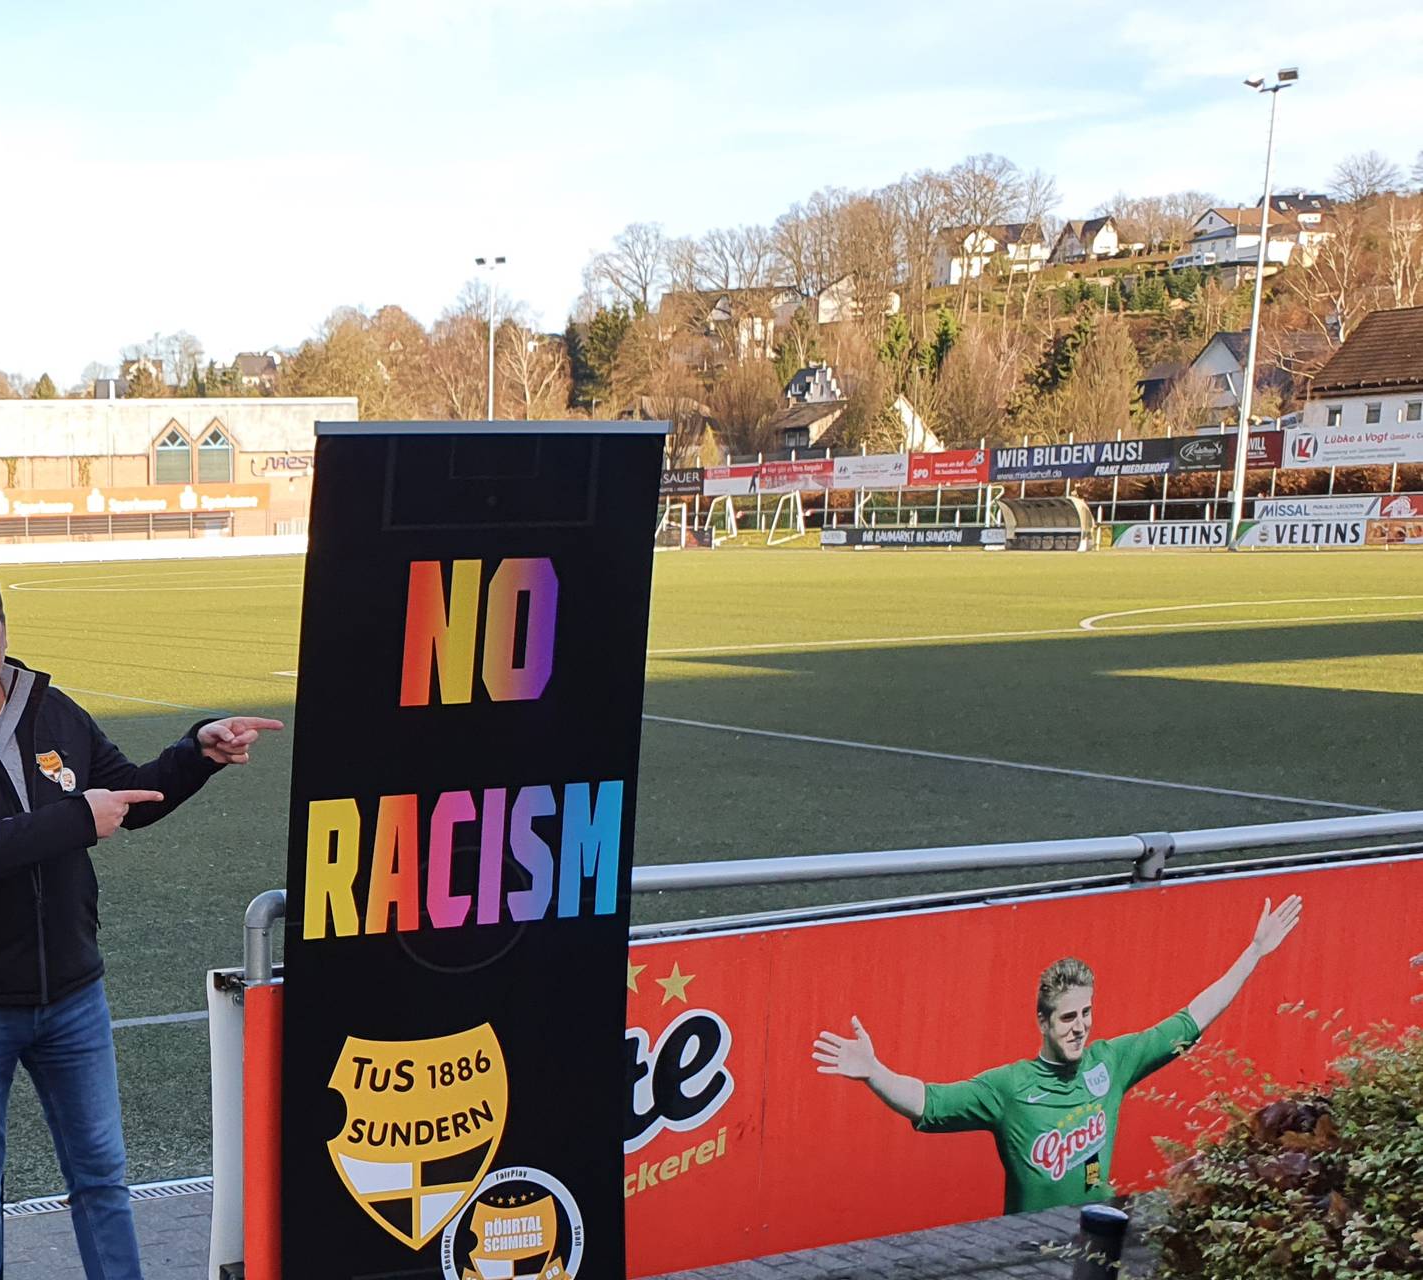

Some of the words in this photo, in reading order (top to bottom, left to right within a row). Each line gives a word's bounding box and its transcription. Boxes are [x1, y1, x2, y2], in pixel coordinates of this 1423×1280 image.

[1365, 432, 1388, 445] Vogt
[997, 449, 1028, 468] WIR
[1033, 445, 1096, 466] BILDEN
[1100, 441, 1143, 462] AUS!
[663, 471, 700, 485] SAUER
[913, 468, 929, 479] SPD
[1094, 465, 1120, 476] FRANZ
[1120, 462, 1170, 475] MIEDERHOFF
[1261, 504, 1310, 517] MISSAL
[876, 530, 915, 542] BAUMARKT
[1147, 524, 1223, 545] VELTINS
[1275, 523, 1361, 545] VELTINS
[399, 557, 559, 707] NO
[303, 779, 624, 940] RACISM
[351, 1056, 415, 1093] TuS
[426, 1049, 492, 1090] 1886
[347, 1099, 495, 1148] SUNDERN
[1032, 1110, 1106, 1180] Grote
[495, 1169, 528, 1180] FairPlay
[483, 1216, 543, 1237] RÖHRTAL
[444, 1235, 452, 1270] Respekt
[483, 1233, 544, 1253] SCHMIEDE
